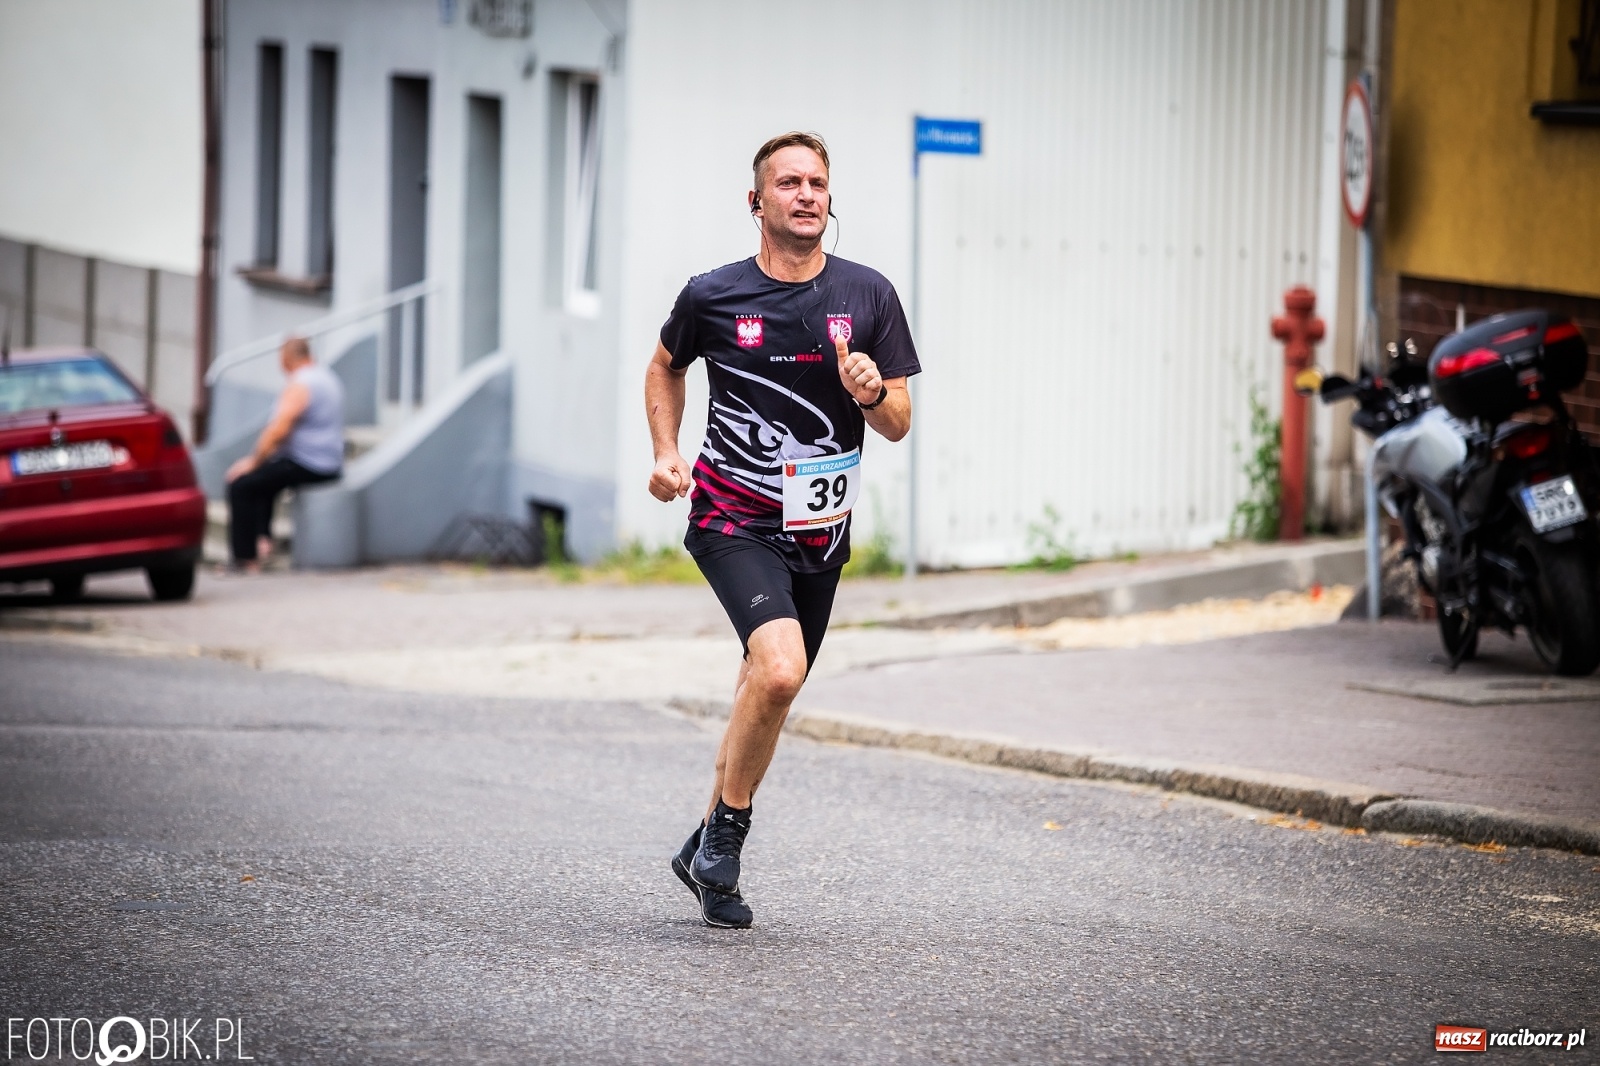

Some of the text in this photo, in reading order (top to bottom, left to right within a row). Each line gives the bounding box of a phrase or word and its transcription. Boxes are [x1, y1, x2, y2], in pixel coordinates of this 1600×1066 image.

[797, 466, 801, 474] I
[802, 464, 819, 474] BIEG
[806, 473, 848, 512] 39
